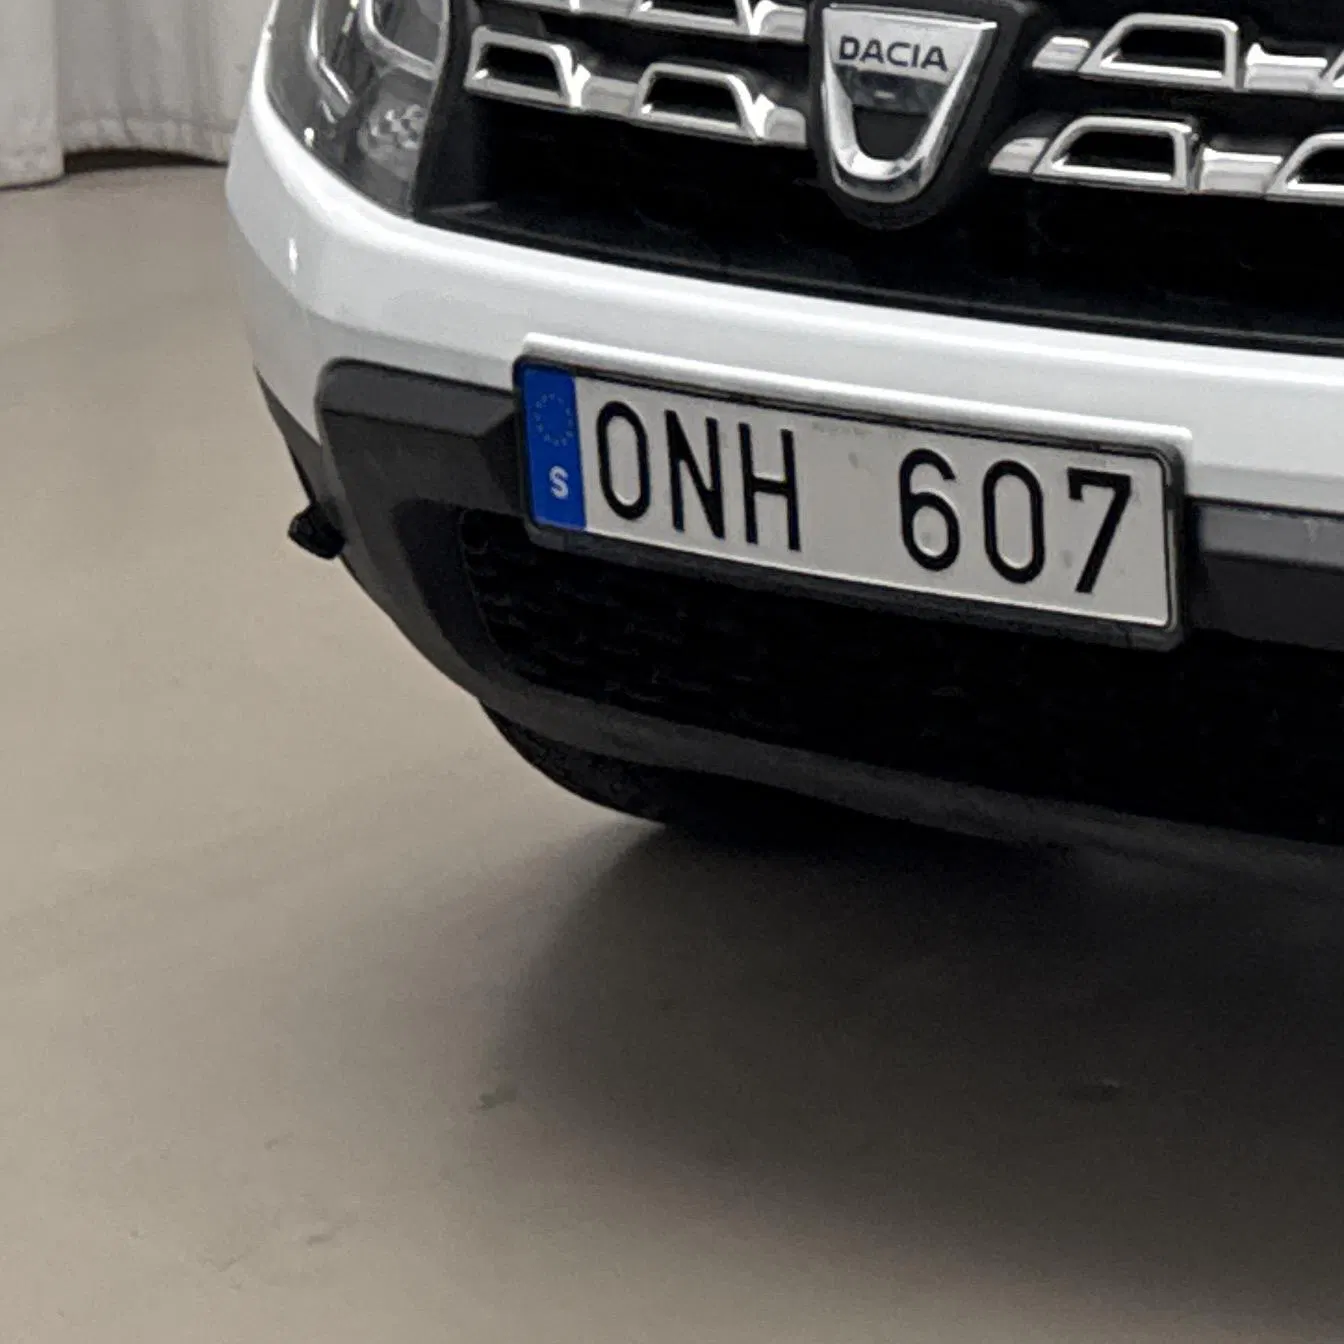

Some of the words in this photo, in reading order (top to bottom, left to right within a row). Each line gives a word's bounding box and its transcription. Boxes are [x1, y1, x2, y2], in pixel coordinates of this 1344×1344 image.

[839, 35, 948, 72] DACIA
[549, 464, 569, 500] S
[597, 401, 802, 552] ONH
[899, 449, 1132, 594] 607
